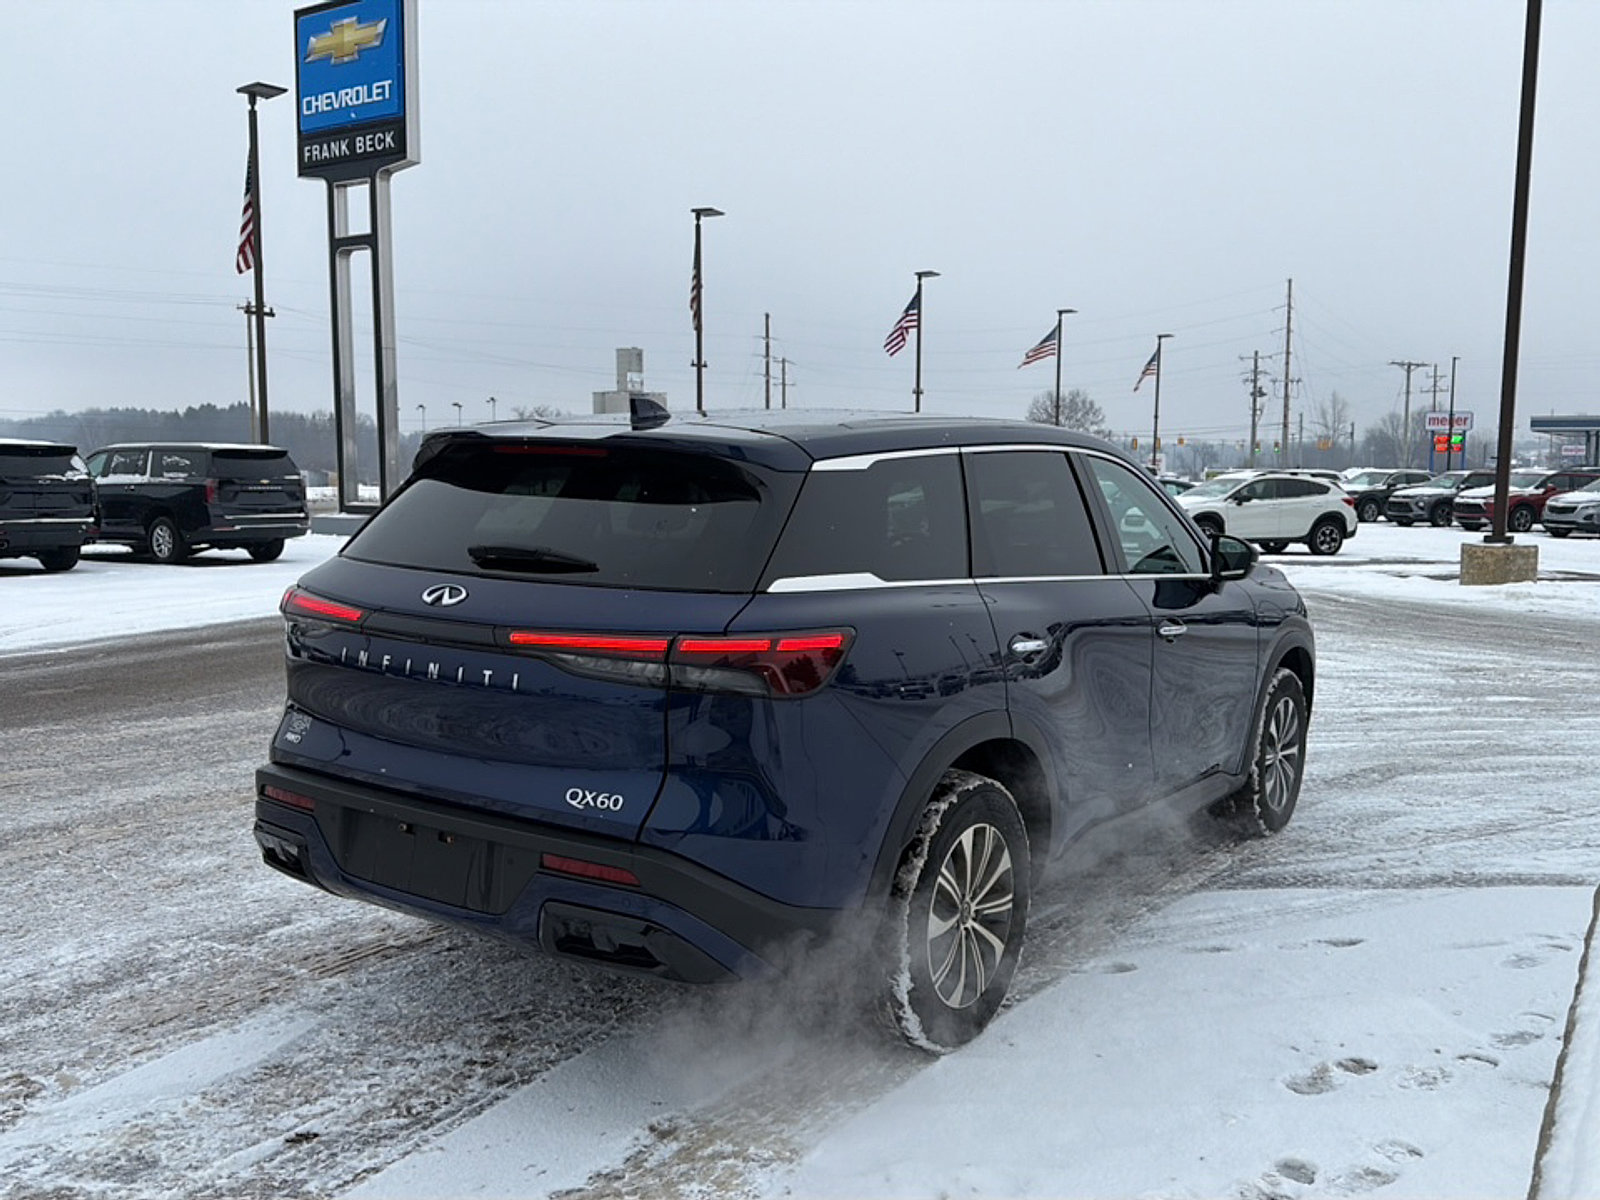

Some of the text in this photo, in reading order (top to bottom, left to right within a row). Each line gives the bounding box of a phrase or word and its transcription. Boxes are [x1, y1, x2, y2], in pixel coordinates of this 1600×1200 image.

[303, 80, 392, 115] CHEVROLET
[303, 130, 395, 163] FRANK BECK
[1428, 416, 1468, 427] meer
[341, 647, 520, 690] INFINITI
[565, 786, 624, 812] QX60
